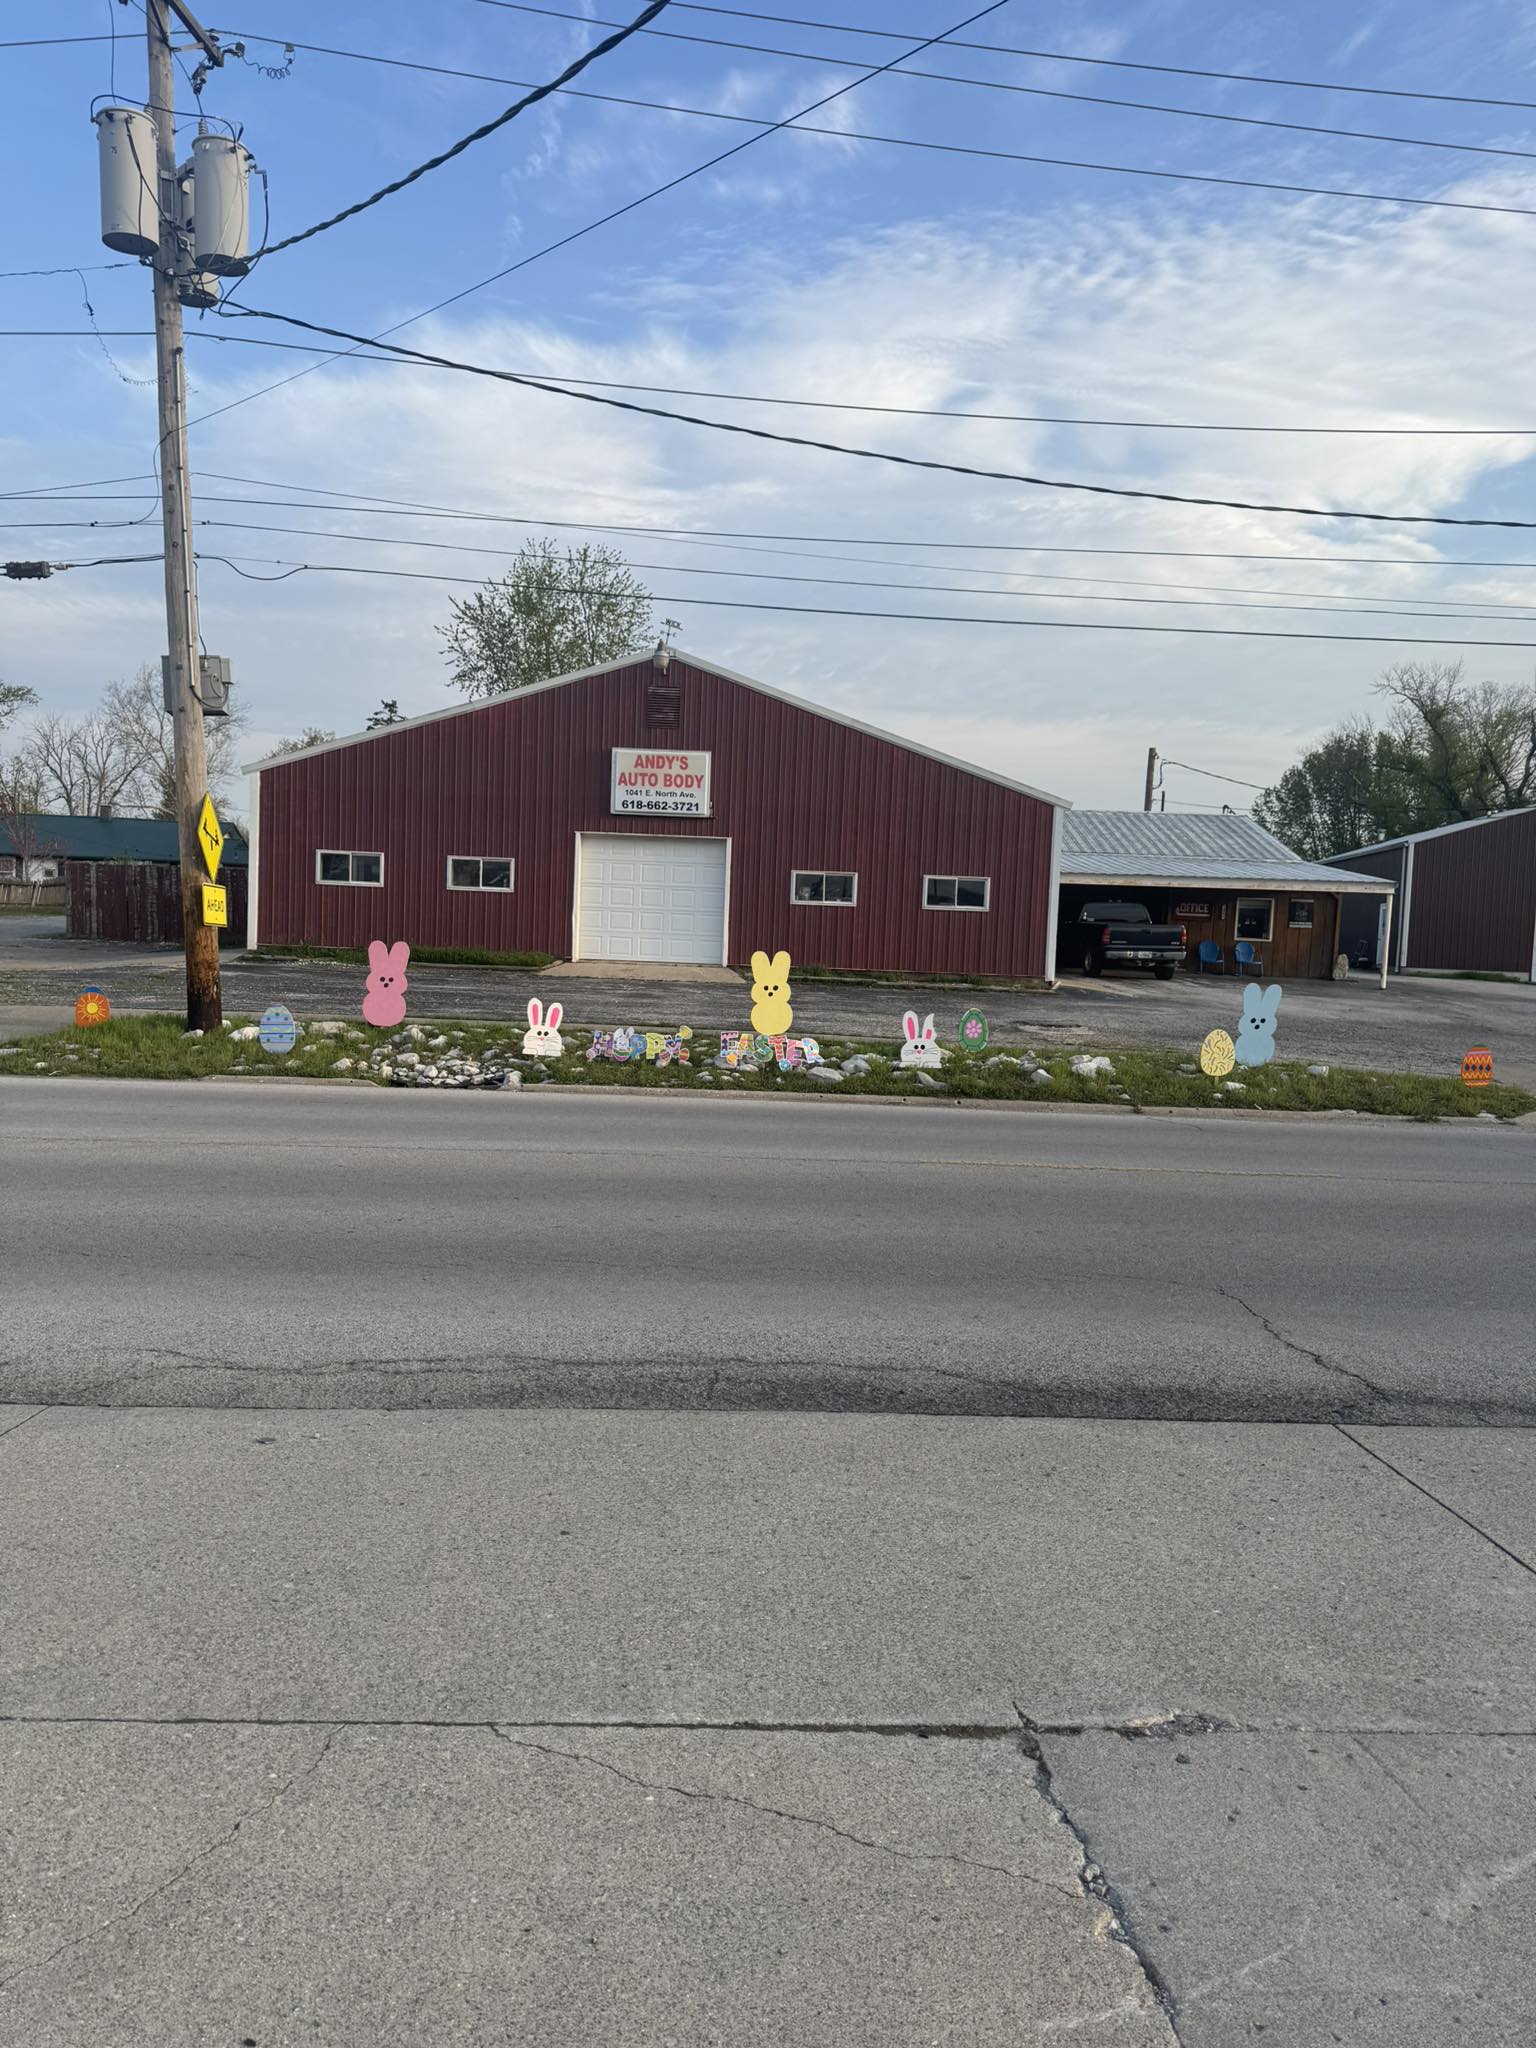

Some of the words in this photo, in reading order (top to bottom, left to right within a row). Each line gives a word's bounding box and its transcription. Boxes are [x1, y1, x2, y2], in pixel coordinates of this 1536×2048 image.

[634, 754, 689, 770] ANDY'S
[618, 772, 658, 787] AUTO
[663, 773, 704, 789] BODY
[656, 790, 678, 798] North
[679, 791, 697, 799] Ave.
[622, 800, 700, 812] 618-662-3721
[207, 898, 225, 912] AHEAD
[1180, 902, 1210, 913] OFFICE
[720, 1031, 825, 1070] EASTER
